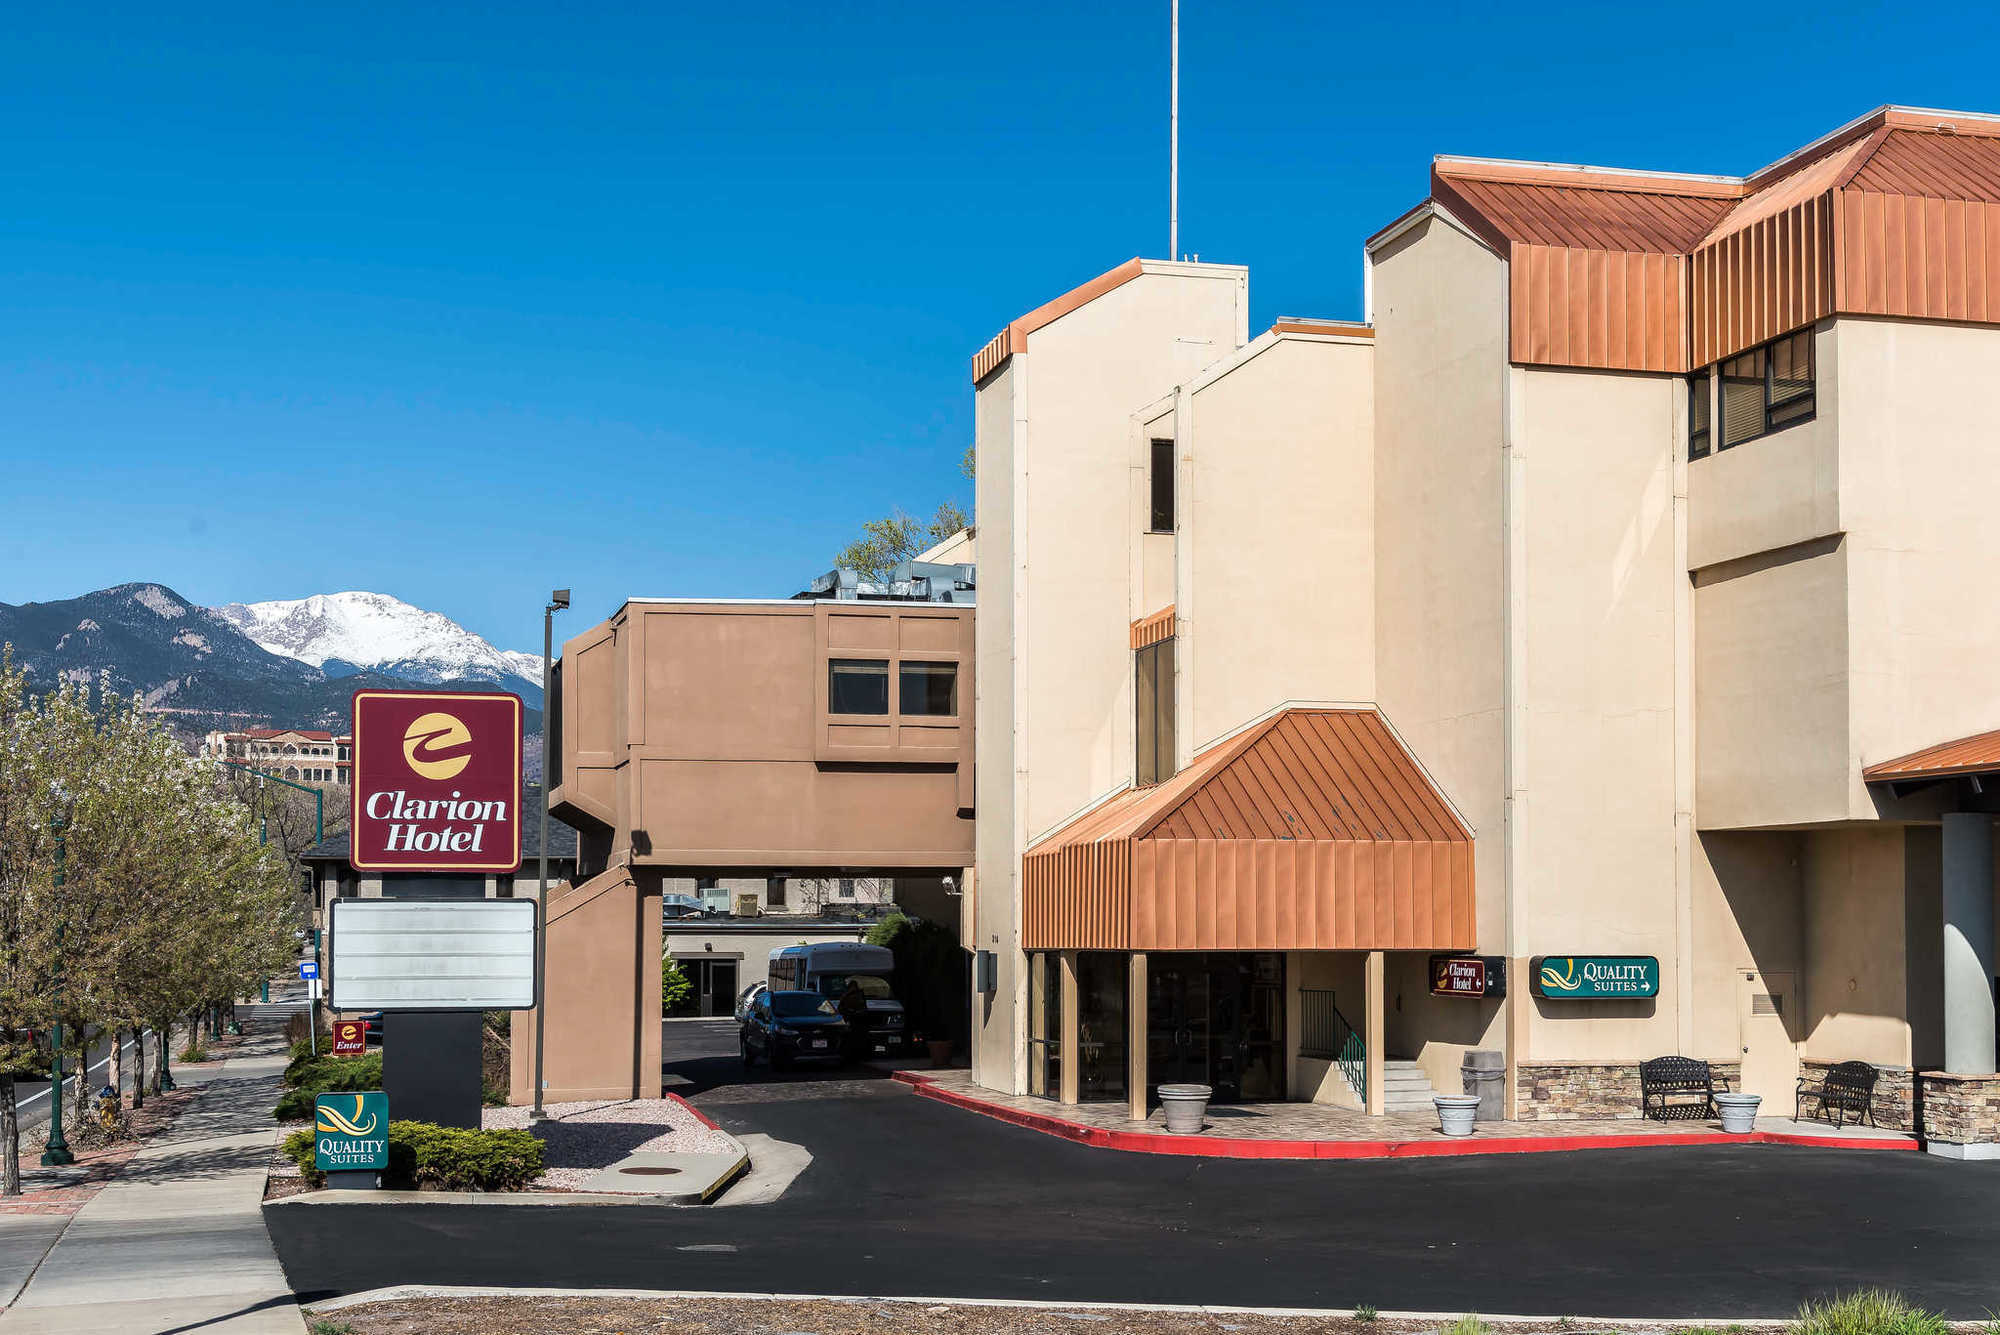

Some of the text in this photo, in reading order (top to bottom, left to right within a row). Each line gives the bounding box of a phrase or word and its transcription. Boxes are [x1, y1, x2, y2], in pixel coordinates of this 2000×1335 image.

[366, 790, 507, 821] Clarion
[384, 824, 484, 852] Hotel
[1449, 963, 1476, 977] Clarion
[1583, 962, 1647, 981] QUALITY
[1453, 977, 1472, 990] Hotel
[1594, 981, 1637, 991] SUITES
[336, 1040, 362, 1050] Enter
[320, 1138, 384, 1156] QUALITY
[330, 1154, 374, 1163] SUITES
